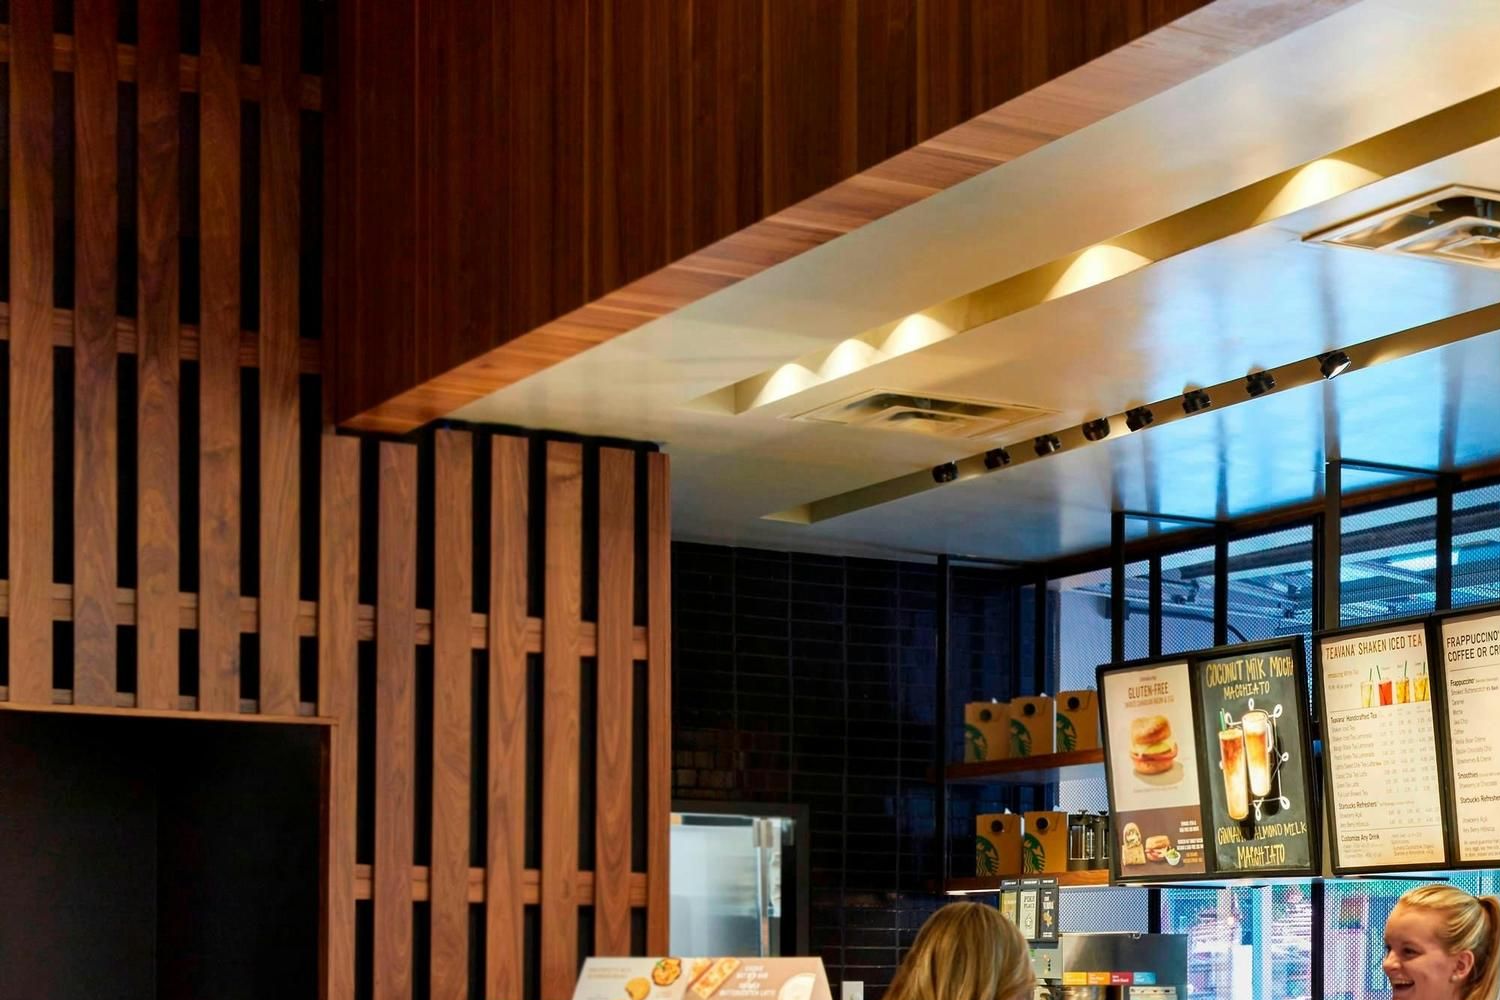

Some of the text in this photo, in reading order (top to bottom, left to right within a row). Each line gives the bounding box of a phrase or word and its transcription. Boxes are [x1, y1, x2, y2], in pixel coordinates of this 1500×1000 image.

[1358, 639, 1387, 655] SHAKEN
[1389, 636, 1406, 651] ICED
[1408, 634, 1423, 648] TEA
[1447, 648, 1475, 662] COFFEE
[1477, 646, 1488, 658] OR
[1206, 660, 1243, 688] COCONUT
[1128, 682, 1168, 699] GLUTEN-FREE
[1224, 681, 1270, 700] MACCHIATO
[1254, 824, 1282, 841] ALMOND
[1284, 821, 1308, 837] MILK
[1237, 843, 1285, 868] MACCHIATO
